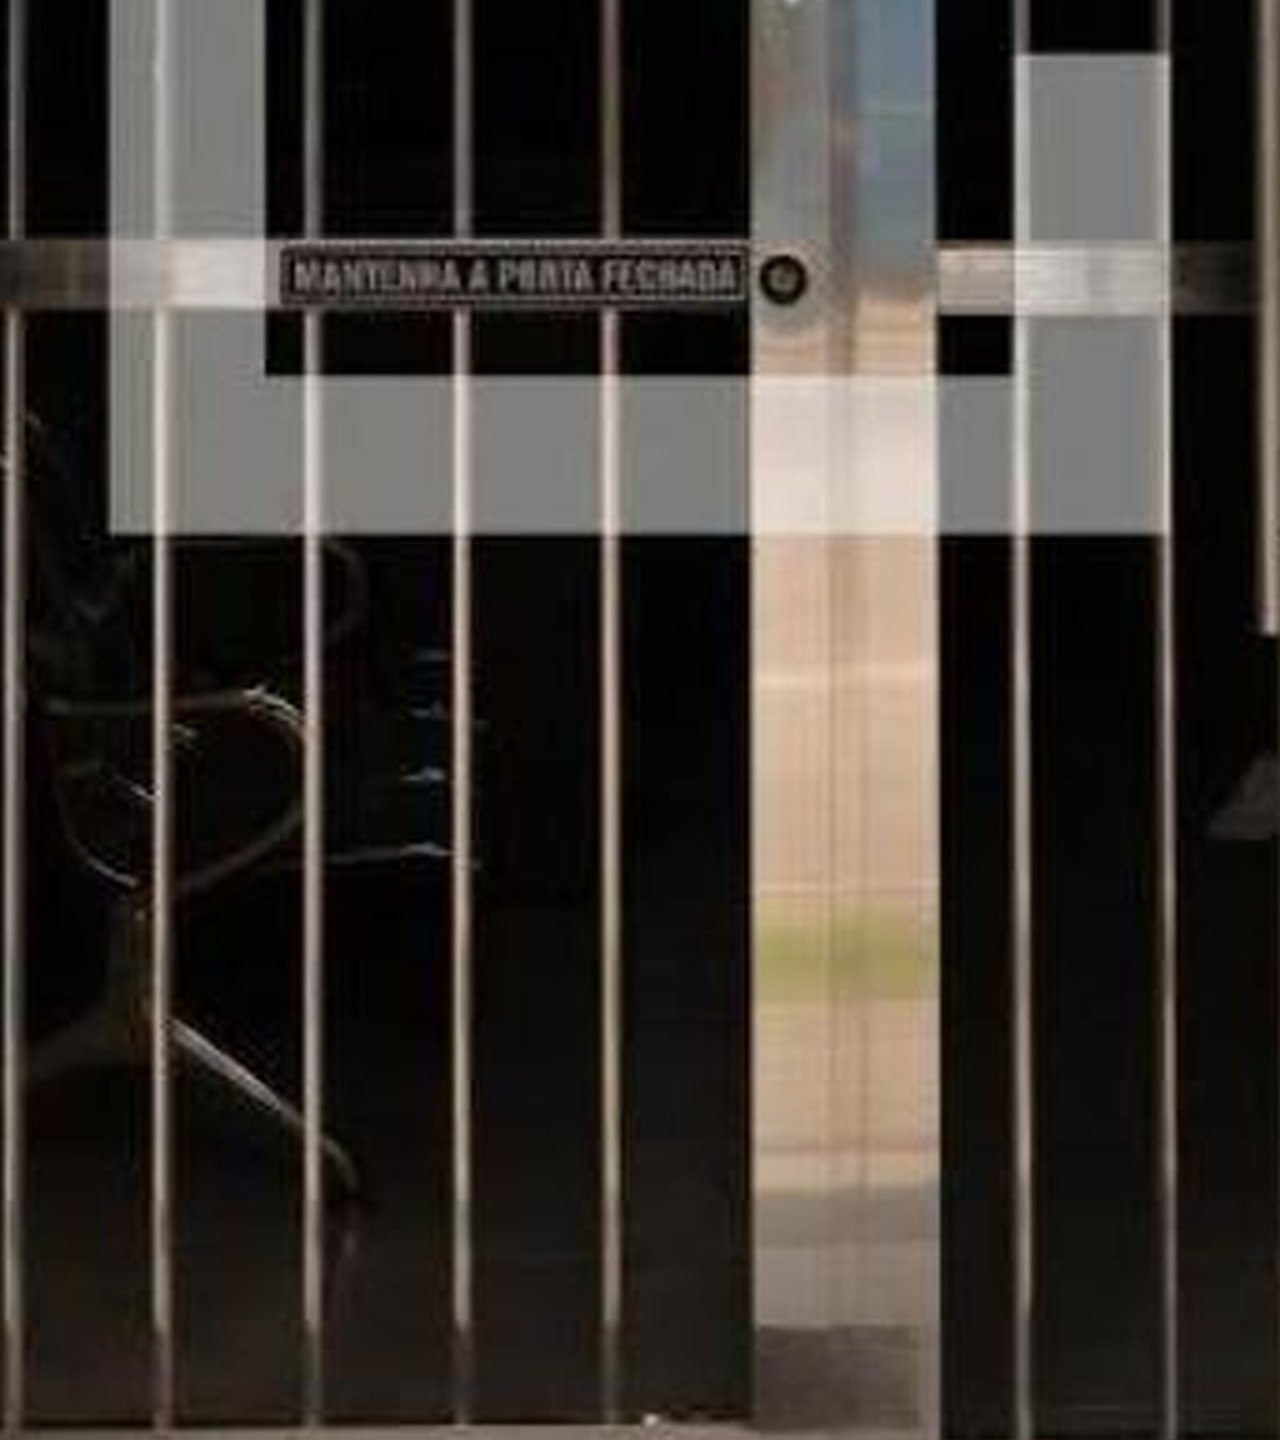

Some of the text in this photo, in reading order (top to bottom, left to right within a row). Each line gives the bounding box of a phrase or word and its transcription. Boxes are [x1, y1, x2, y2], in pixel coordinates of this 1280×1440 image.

[293, 256, 738, 294] MANTENHA A PORTA FECHADA
